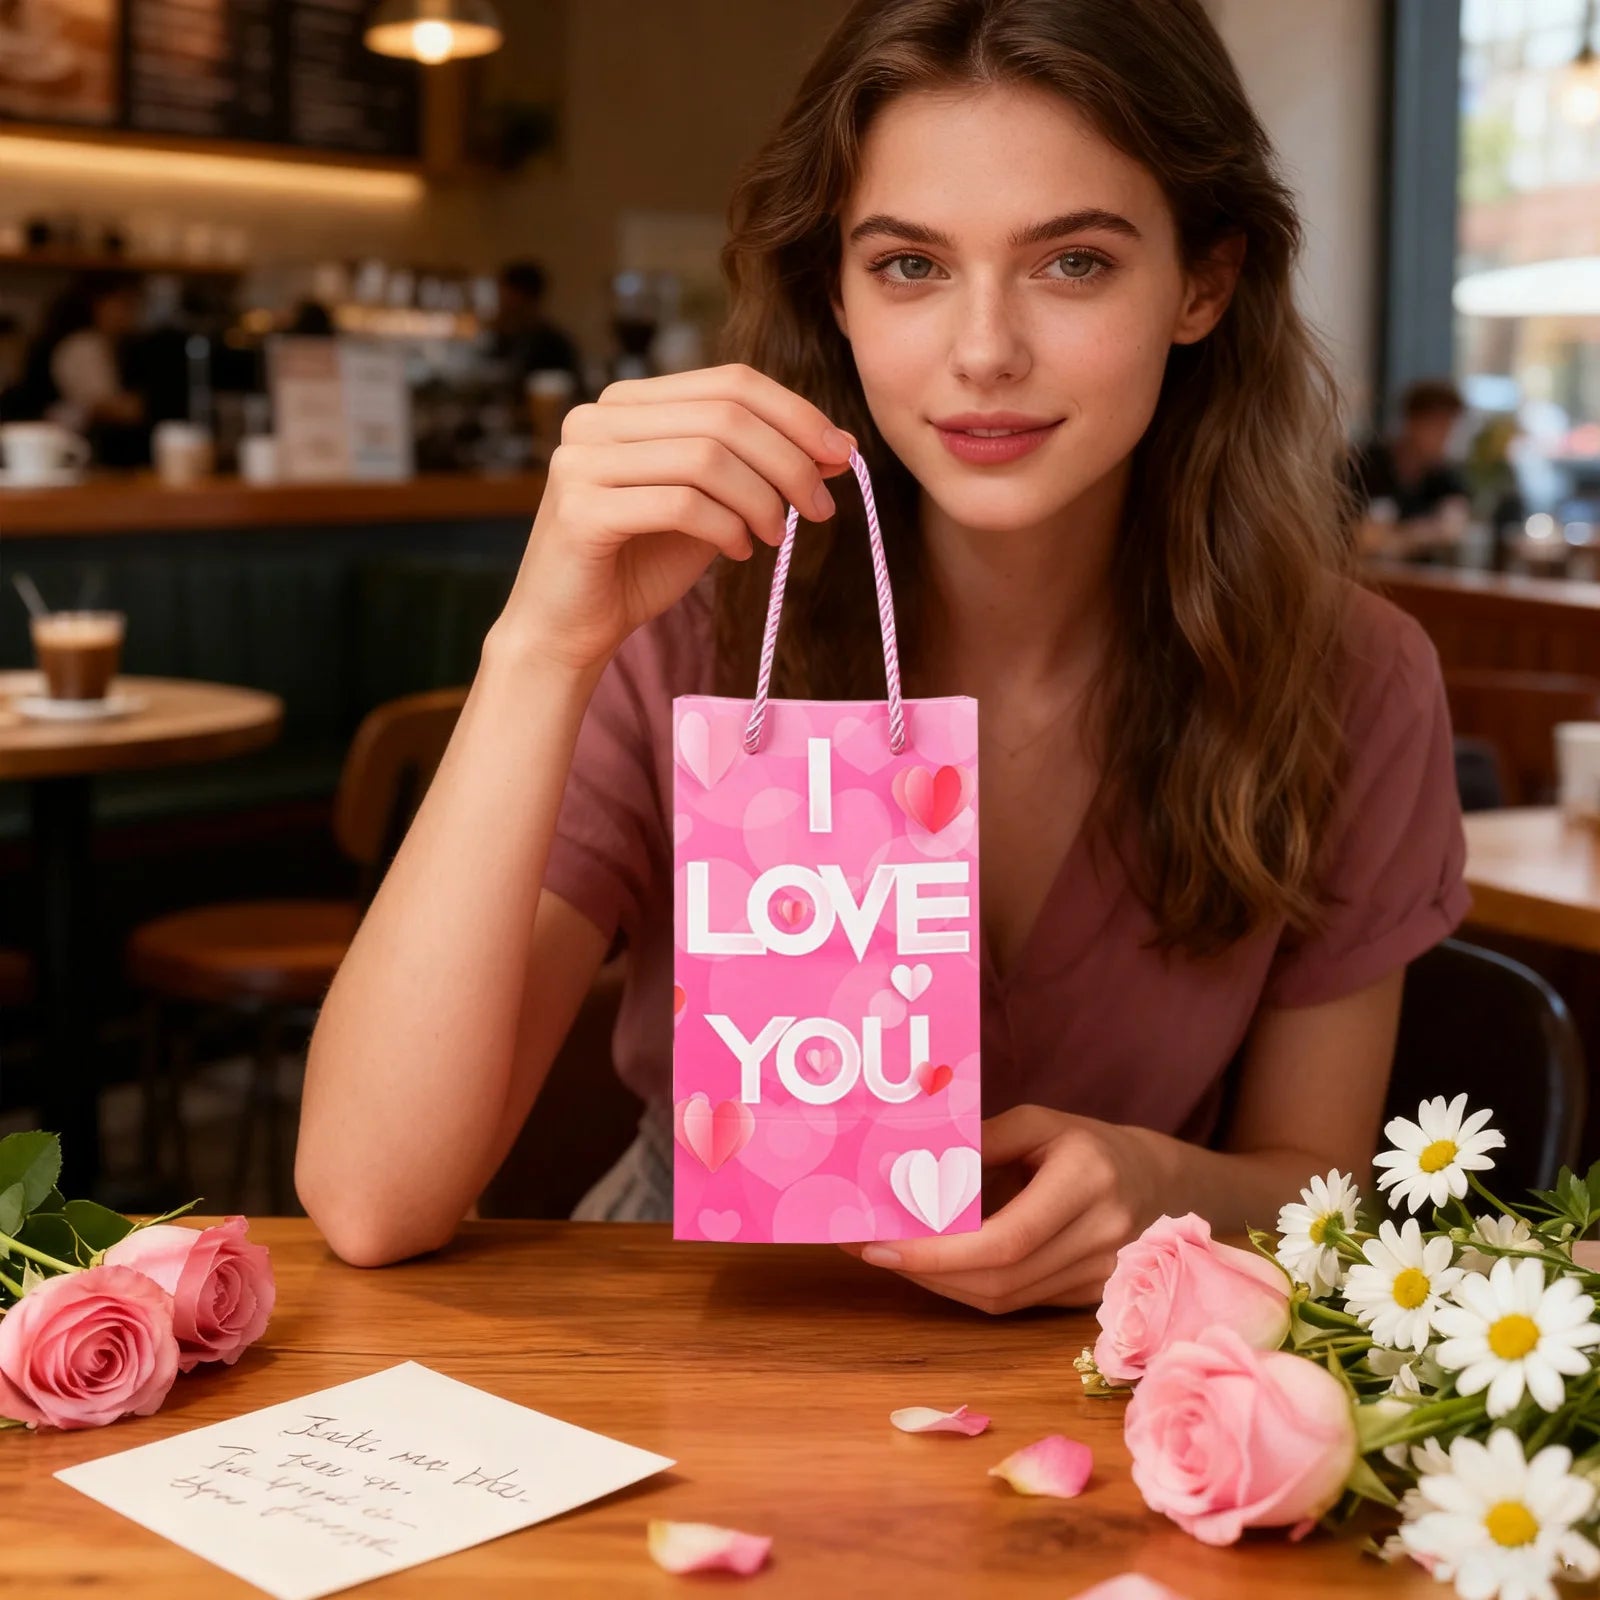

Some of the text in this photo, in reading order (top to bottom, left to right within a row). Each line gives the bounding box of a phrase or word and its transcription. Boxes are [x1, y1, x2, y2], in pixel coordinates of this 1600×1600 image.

[808, 738, 832, 832] I
[687, 861, 969, 962] LOVE
[704, 1014, 929, 1104] YOU
